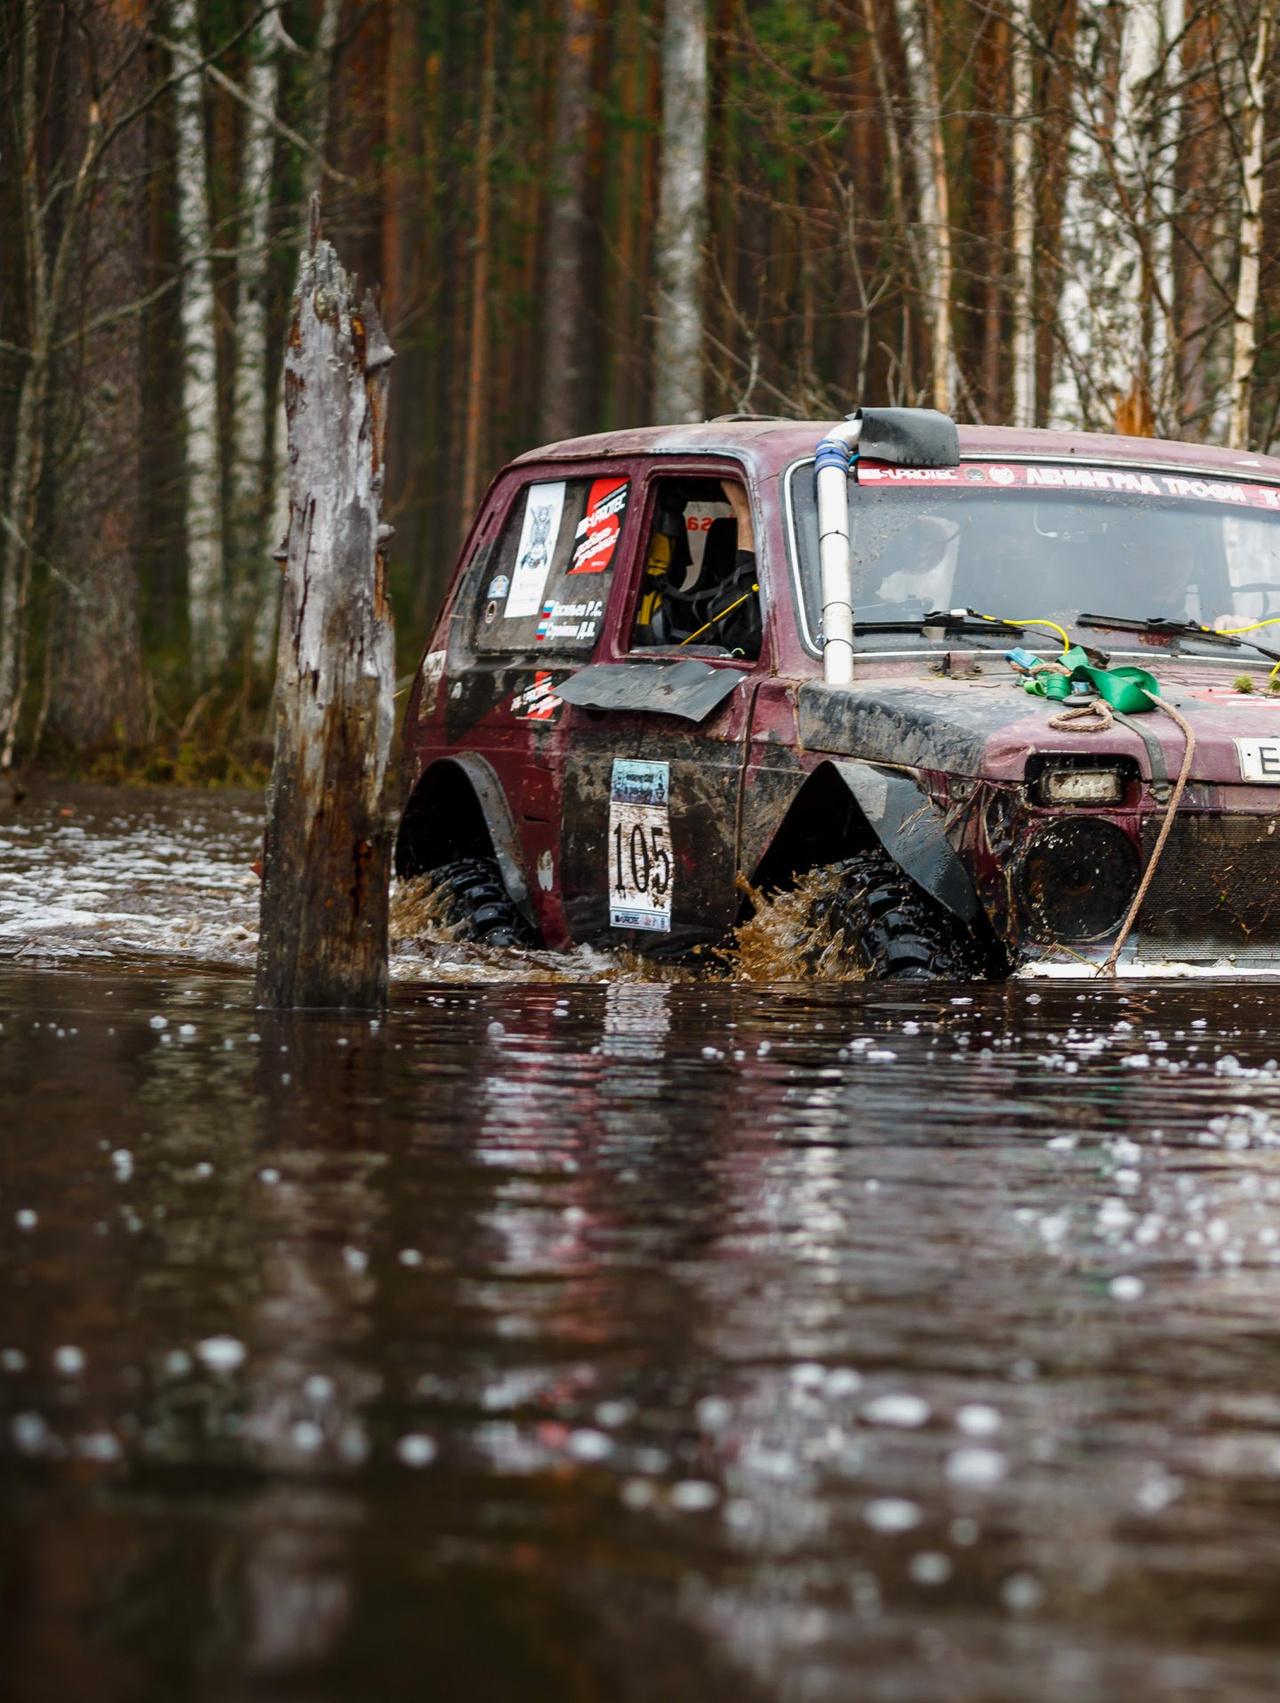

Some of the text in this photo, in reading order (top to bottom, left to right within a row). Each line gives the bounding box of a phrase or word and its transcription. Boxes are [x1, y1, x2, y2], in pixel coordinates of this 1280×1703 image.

[878, 468, 958, 480] SUPROTEC
[1026, 468, 1161, 495] ЛЕНИНГРАД
[1162, 477, 1246, 501] ТРОФИ
[614, 823, 669, 895] 105
